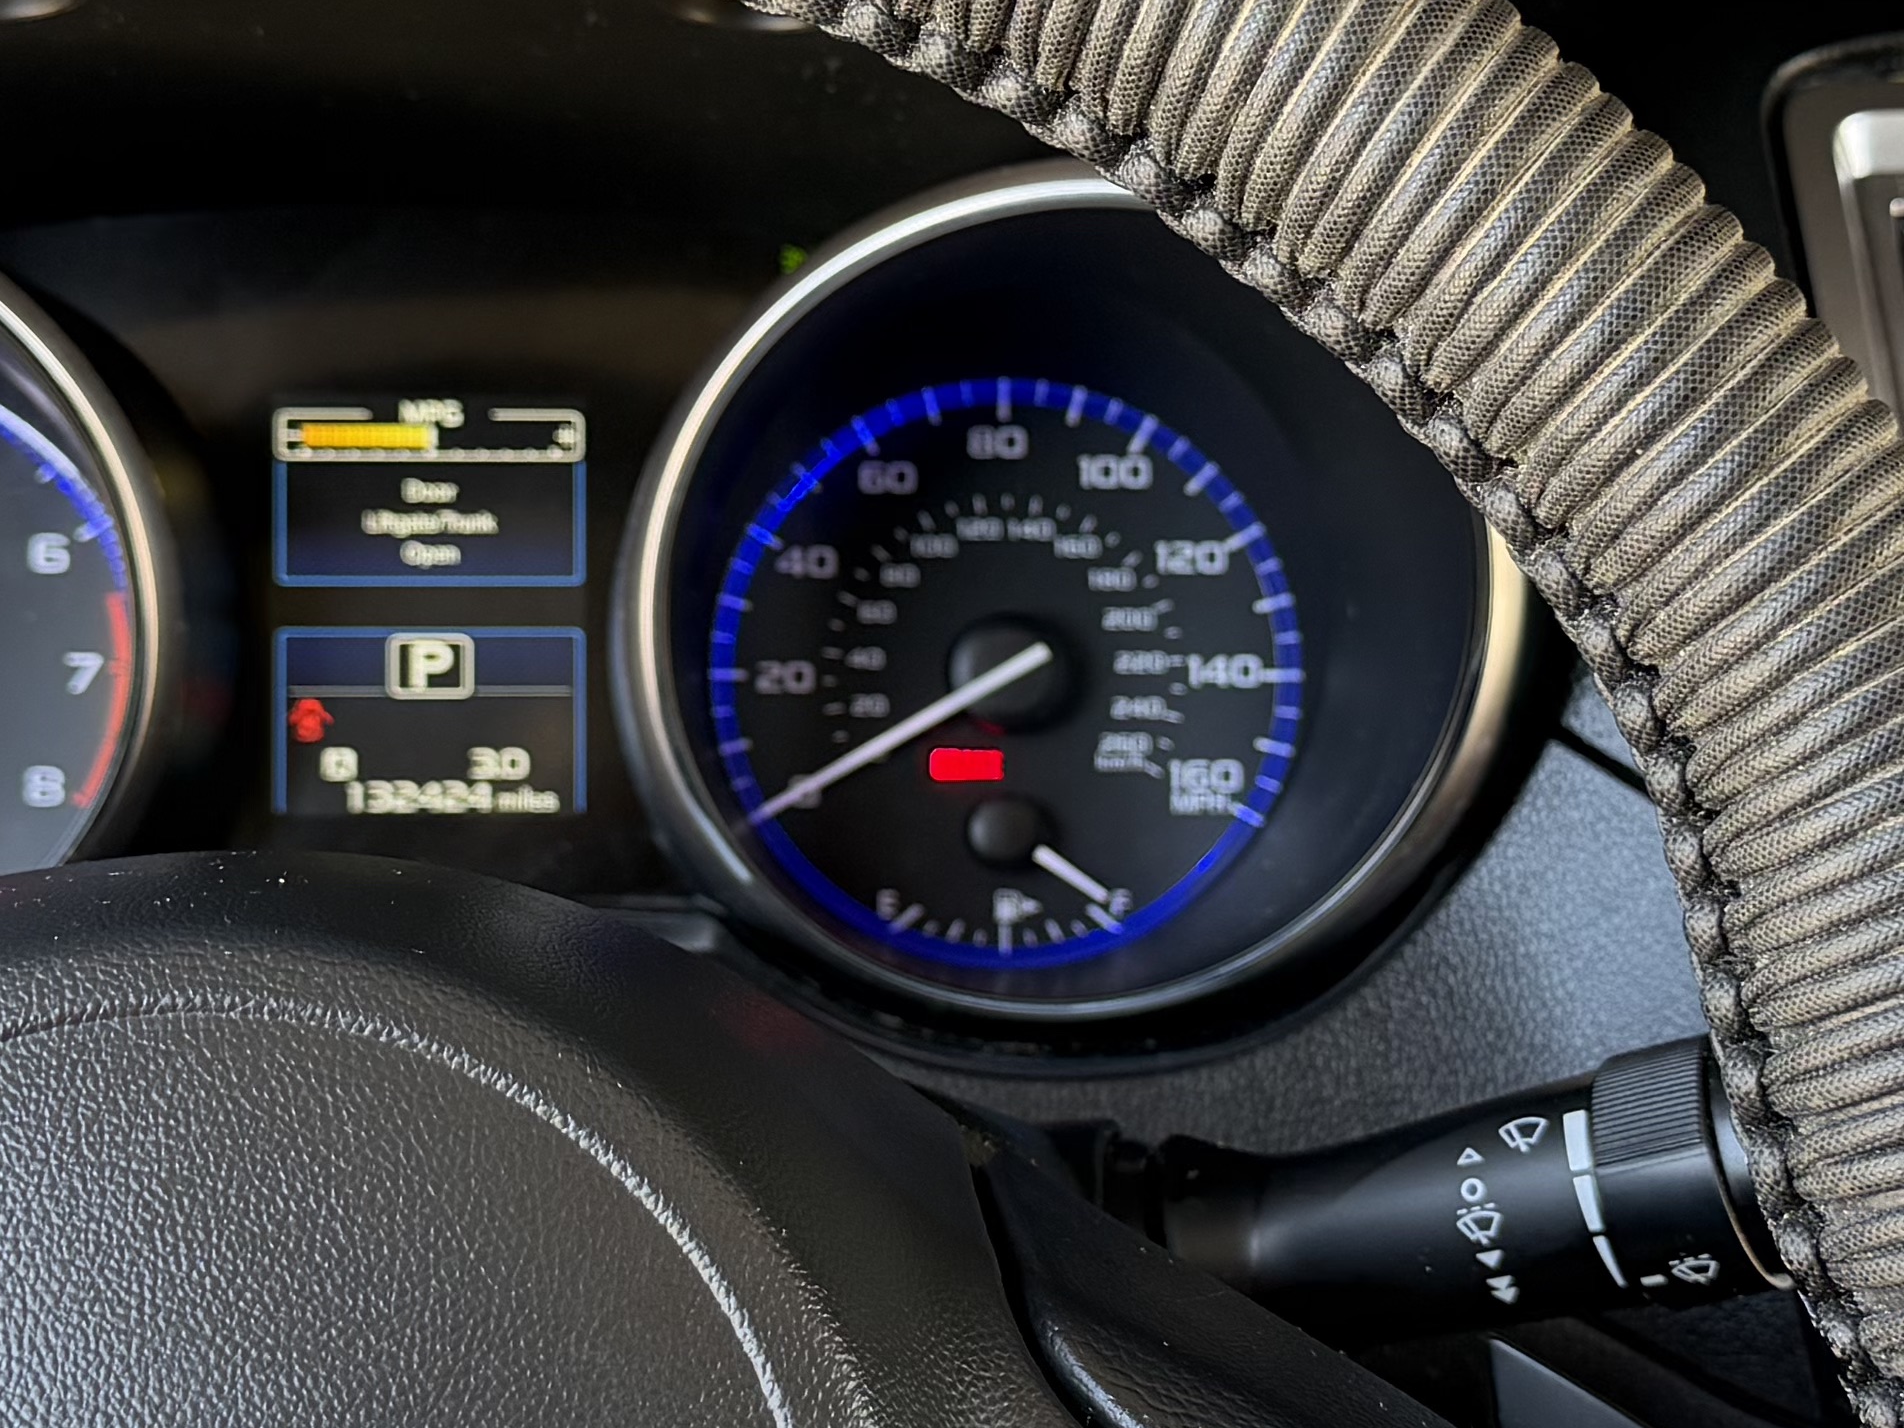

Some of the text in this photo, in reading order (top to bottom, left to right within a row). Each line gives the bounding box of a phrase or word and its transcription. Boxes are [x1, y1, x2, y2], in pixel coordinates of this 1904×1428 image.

[966, 425, 1028, 460] 80
[1077, 454, 1153, 490] 100
[27, 533, 72, 575] 6
[775, 544, 839, 580] 40
[1154, 539, 1229, 575] 120
[63, 653, 104, 694] 7
[408, 641, 455, 692] P
[754, 660, 816, 695] 20
[1187, 653, 1263, 689] 140
[24, 766, 65, 809] 8
